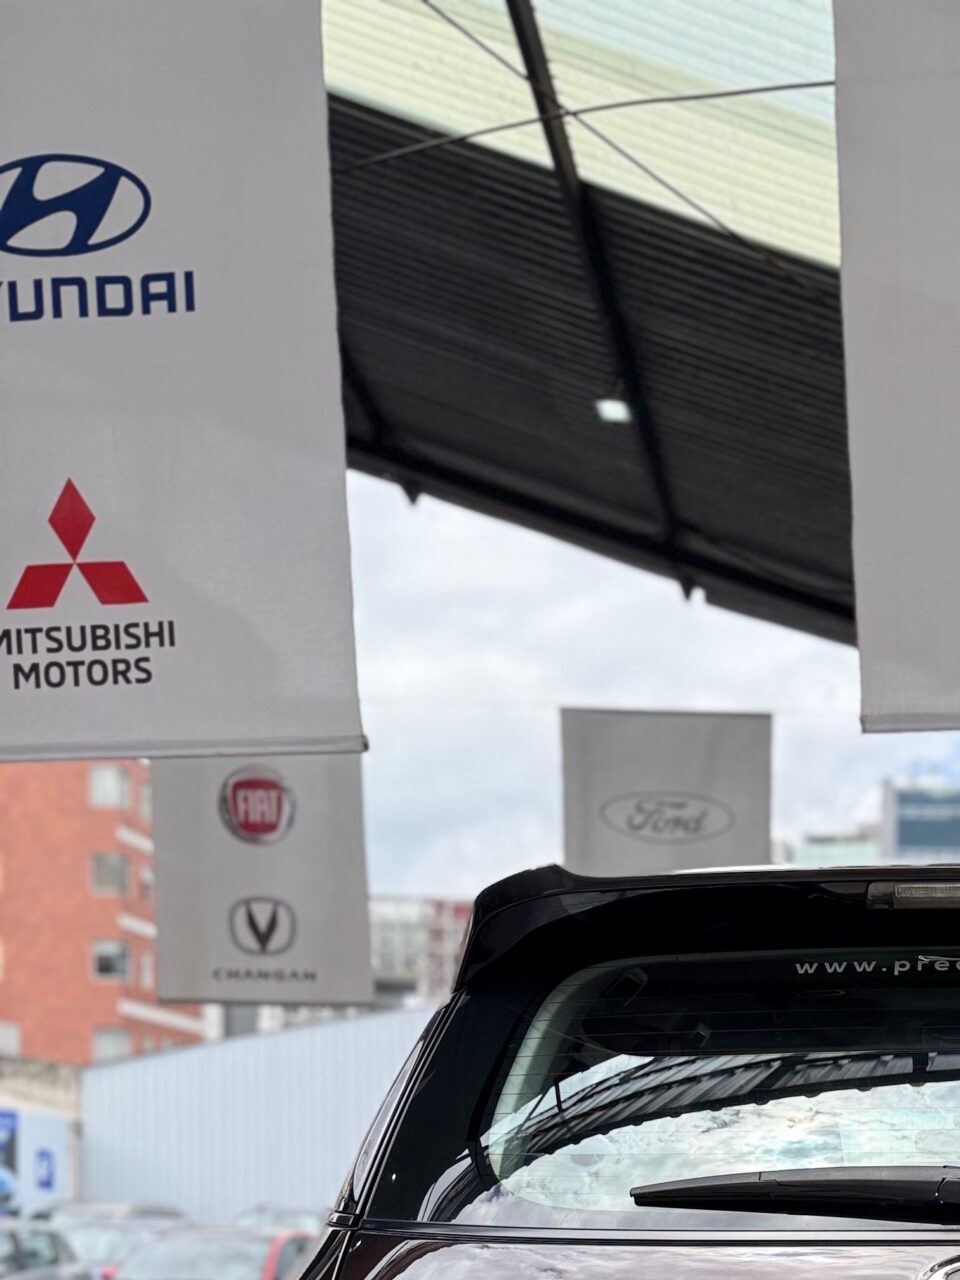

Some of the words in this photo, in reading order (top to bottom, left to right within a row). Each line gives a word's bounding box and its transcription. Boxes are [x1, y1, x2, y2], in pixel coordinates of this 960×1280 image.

[0, 270, 196, 322] UNDAI
[13, 656, 153, 690] MOTORS
[235, 788, 280, 824] FIAT
[625, 797, 708, 835] Ford
[213, 967, 317, 982] CHANGAN
